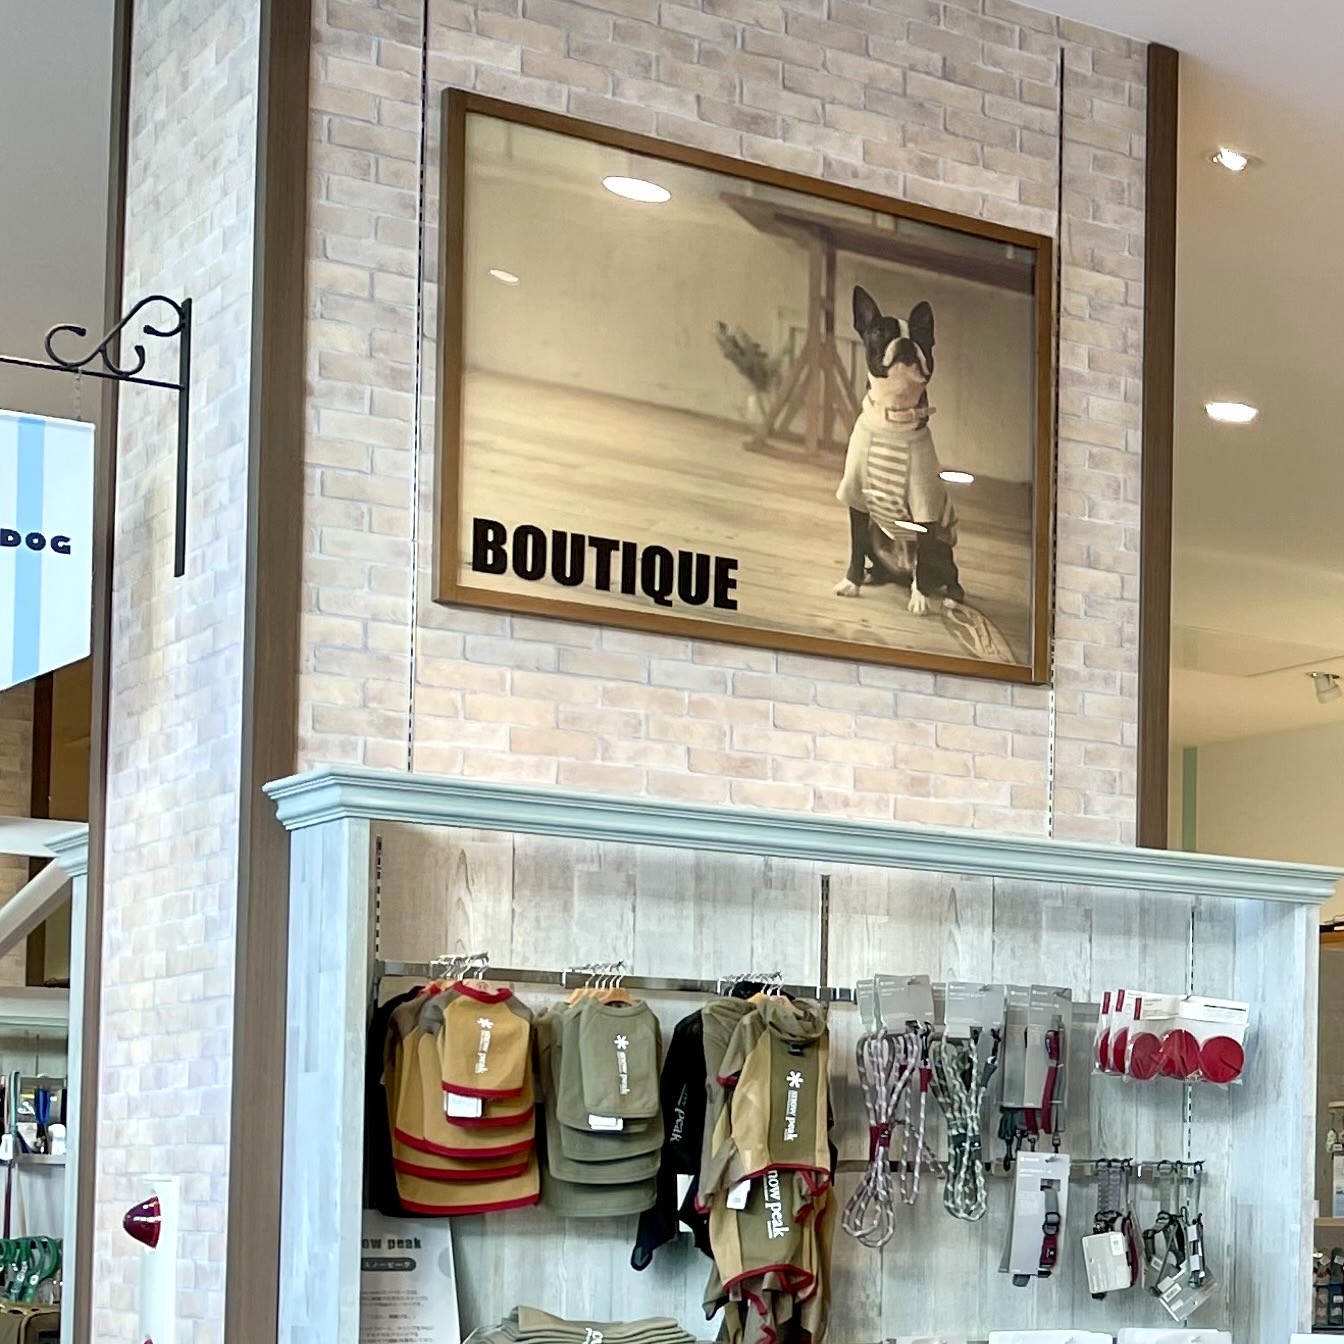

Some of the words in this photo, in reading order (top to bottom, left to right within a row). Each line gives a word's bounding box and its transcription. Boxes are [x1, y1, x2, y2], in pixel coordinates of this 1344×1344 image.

[0, 528, 71, 555] DOG
[472, 517, 738, 610] BOUTIQUE
[783, 1116, 799, 1142] peak
[764, 1201, 790, 1239] peak
[388, 1237, 422, 1250] peak
